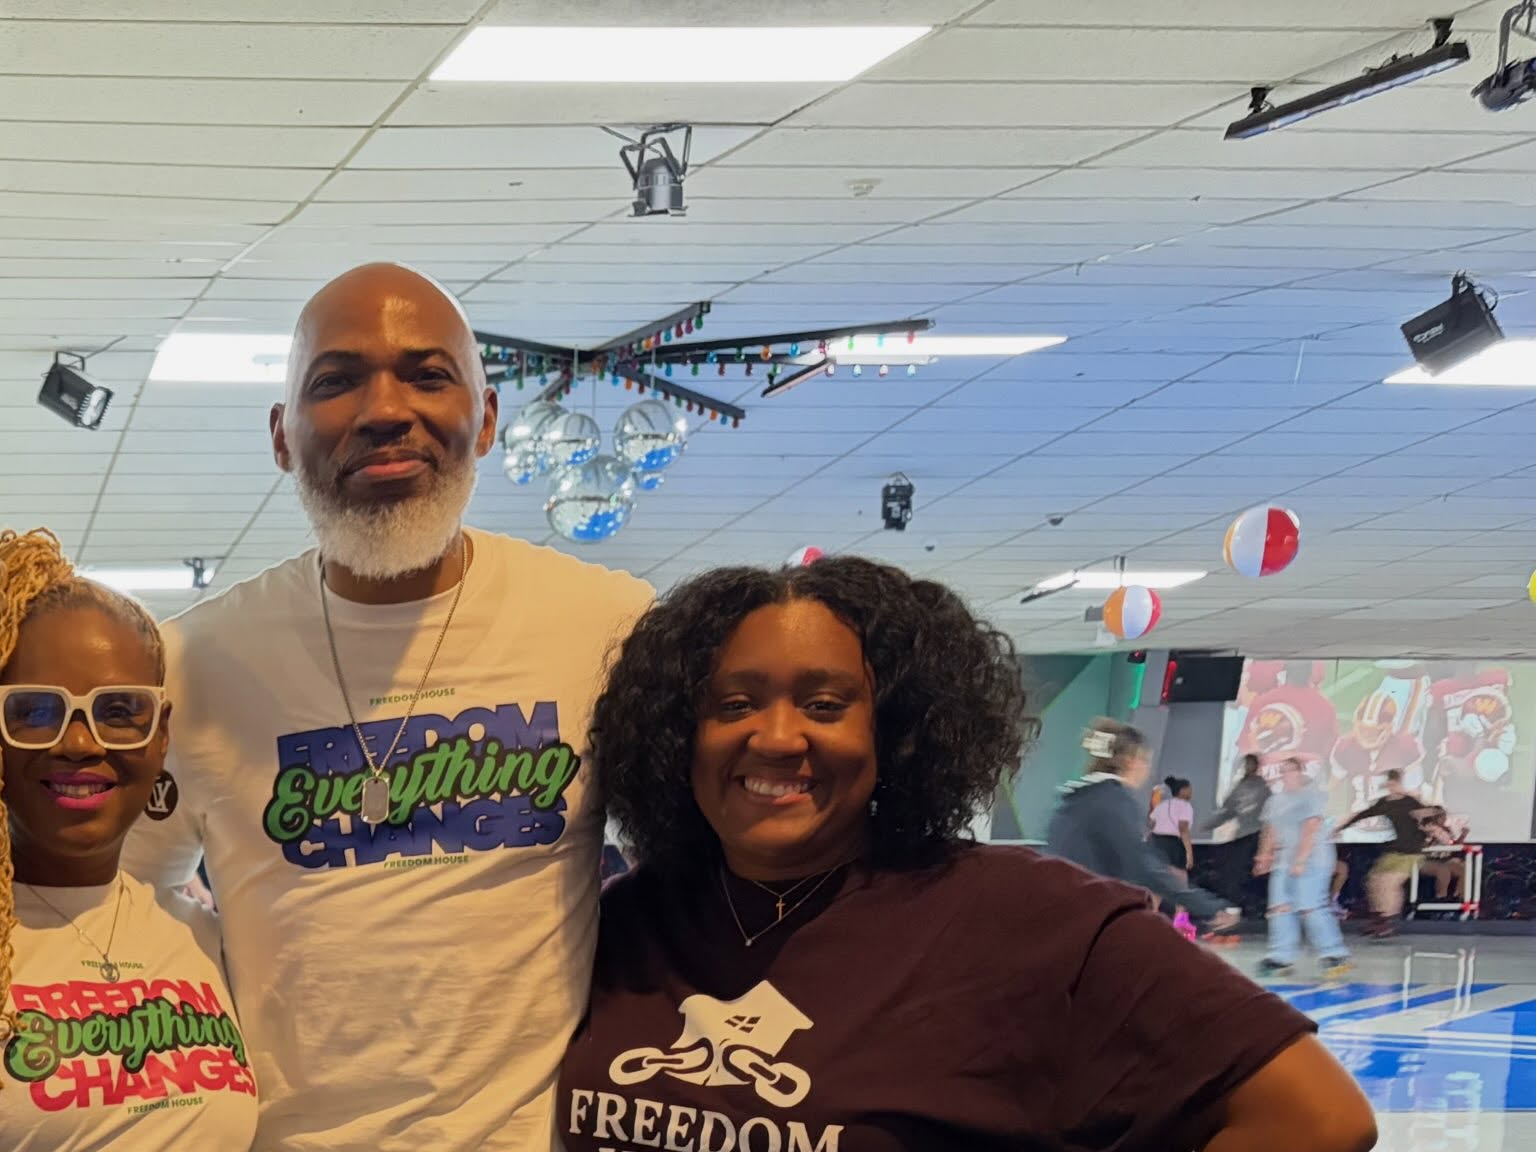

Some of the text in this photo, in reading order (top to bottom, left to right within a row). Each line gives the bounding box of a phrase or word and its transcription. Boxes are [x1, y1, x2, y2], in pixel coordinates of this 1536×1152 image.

[420, 687, 456, 700] HOUSE
[277, 701, 561, 776] FREEDOM
[263, 736, 580, 843] Eveything
[281, 794, 569, 870] CHANGES
[383, 854, 470, 869] FREEDOM HOUSE
[9, 978, 223, 1020] FREEDOM
[4, 996, 248, 1083] Everything
[171, 1096, 204, 1109] HOUSE
